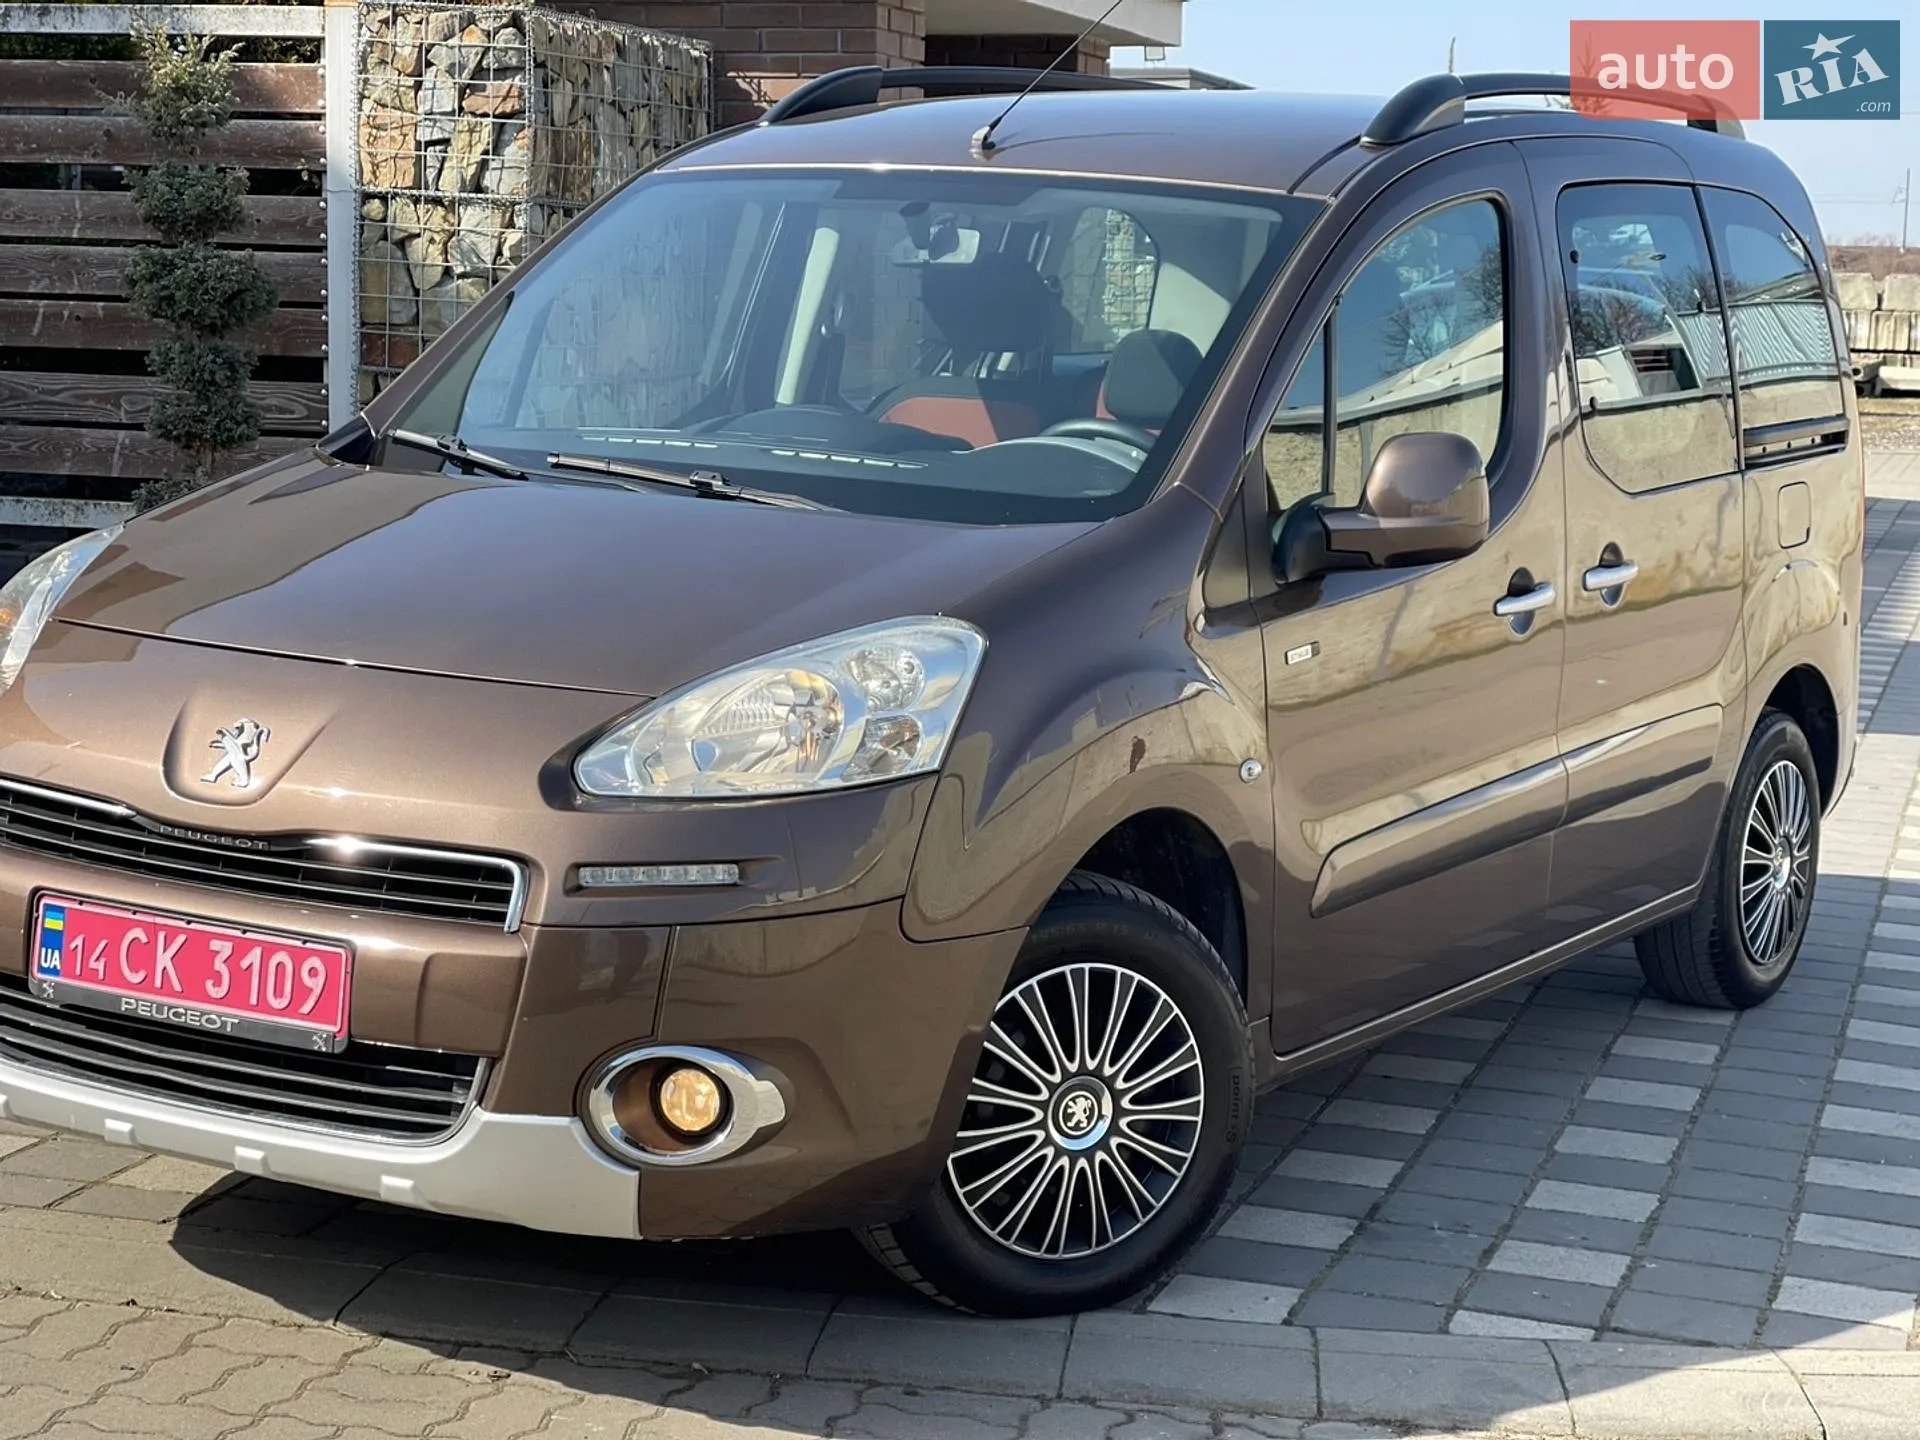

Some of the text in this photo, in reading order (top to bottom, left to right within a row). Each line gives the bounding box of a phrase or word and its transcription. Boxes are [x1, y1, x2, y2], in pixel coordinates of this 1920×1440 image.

[159, 825, 270, 851] PEUGEOT
[40, 947, 62, 971] UA
[69, 934, 110, 981] 14
[204, 938, 328, 1016] 3109
[120, 997, 240, 1032] PEUGEOT
